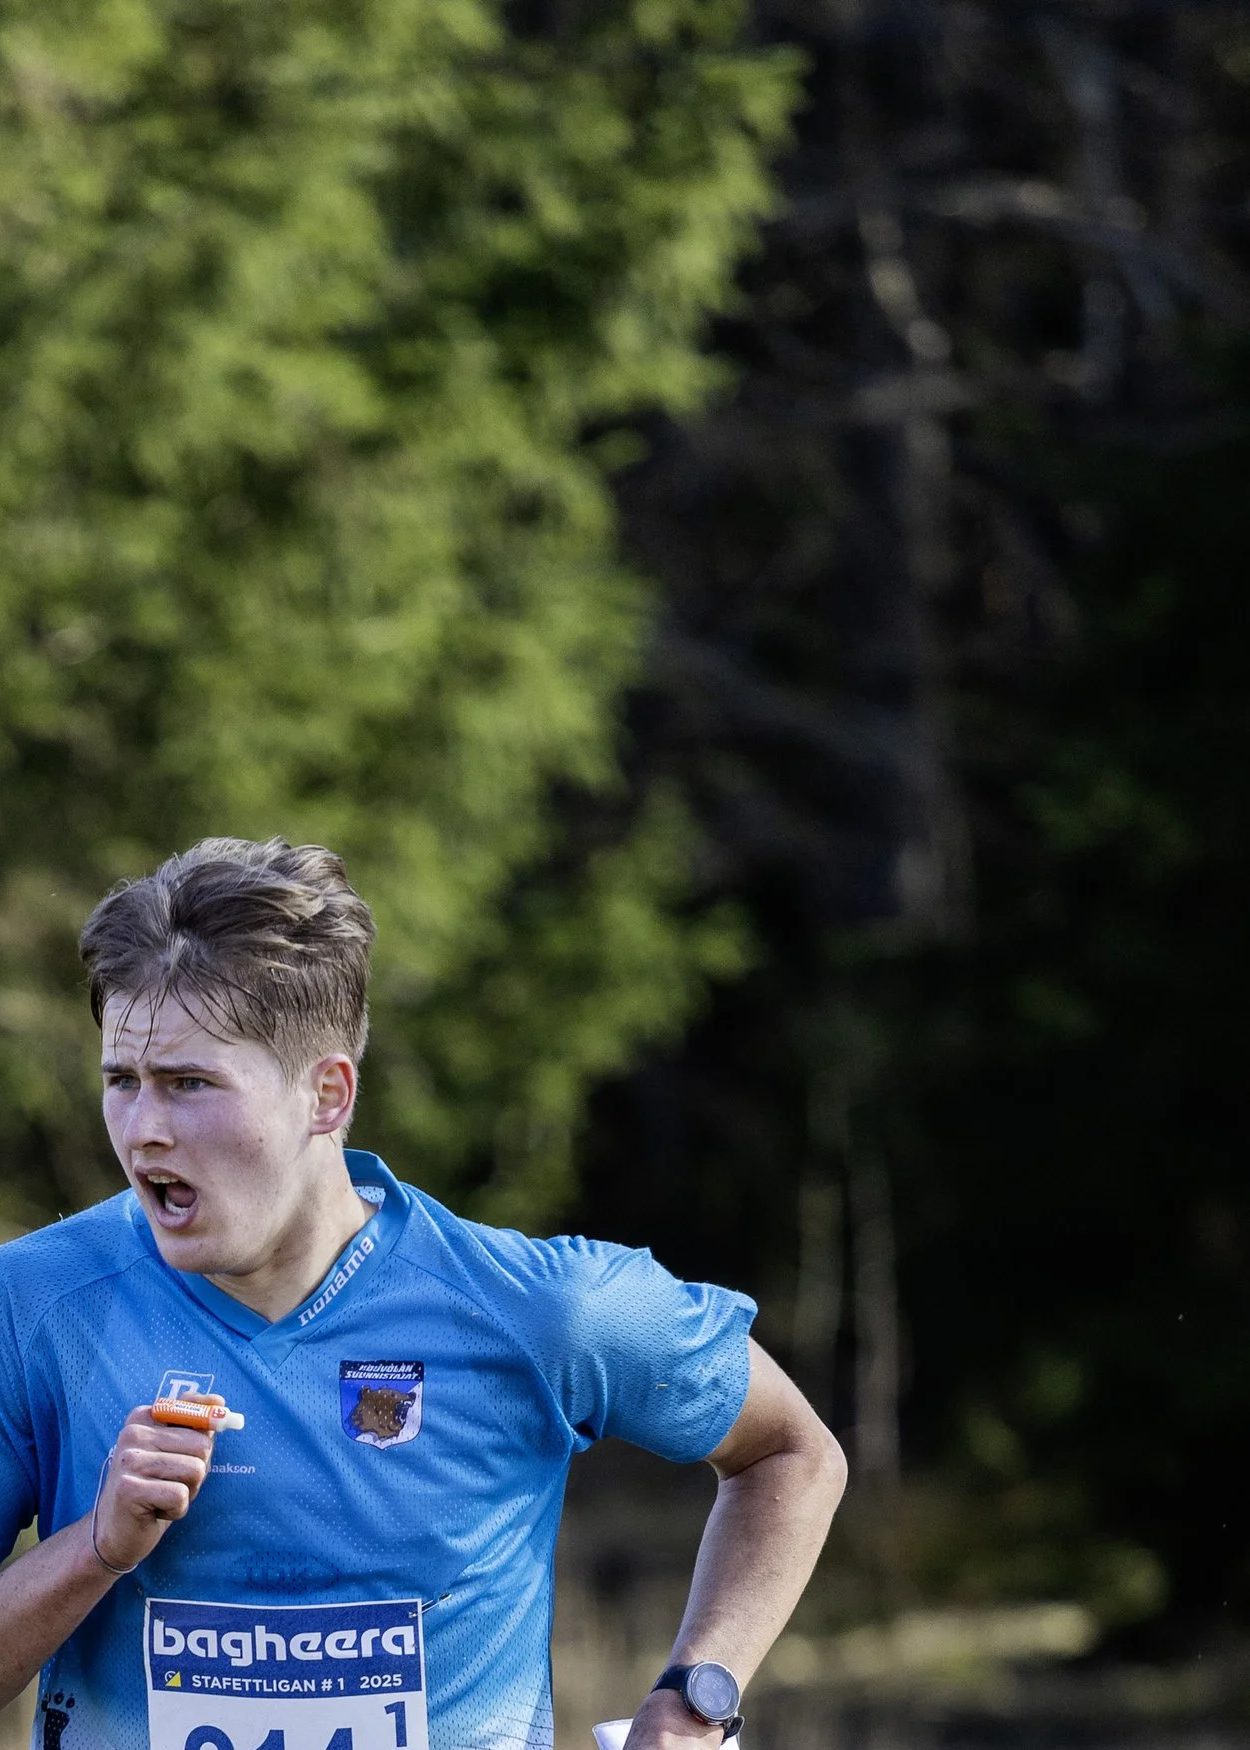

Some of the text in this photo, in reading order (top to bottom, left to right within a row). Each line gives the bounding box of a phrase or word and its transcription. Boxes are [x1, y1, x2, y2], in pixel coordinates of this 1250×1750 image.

[209, 1462, 256, 1474] aakson
[153, 1619, 416, 1667] bagheera
[192, 1674, 316, 1693] STAFETTLIGAN
[360, 1673, 403, 1689] 2025
[384, 1700, 408, 1748] 1
